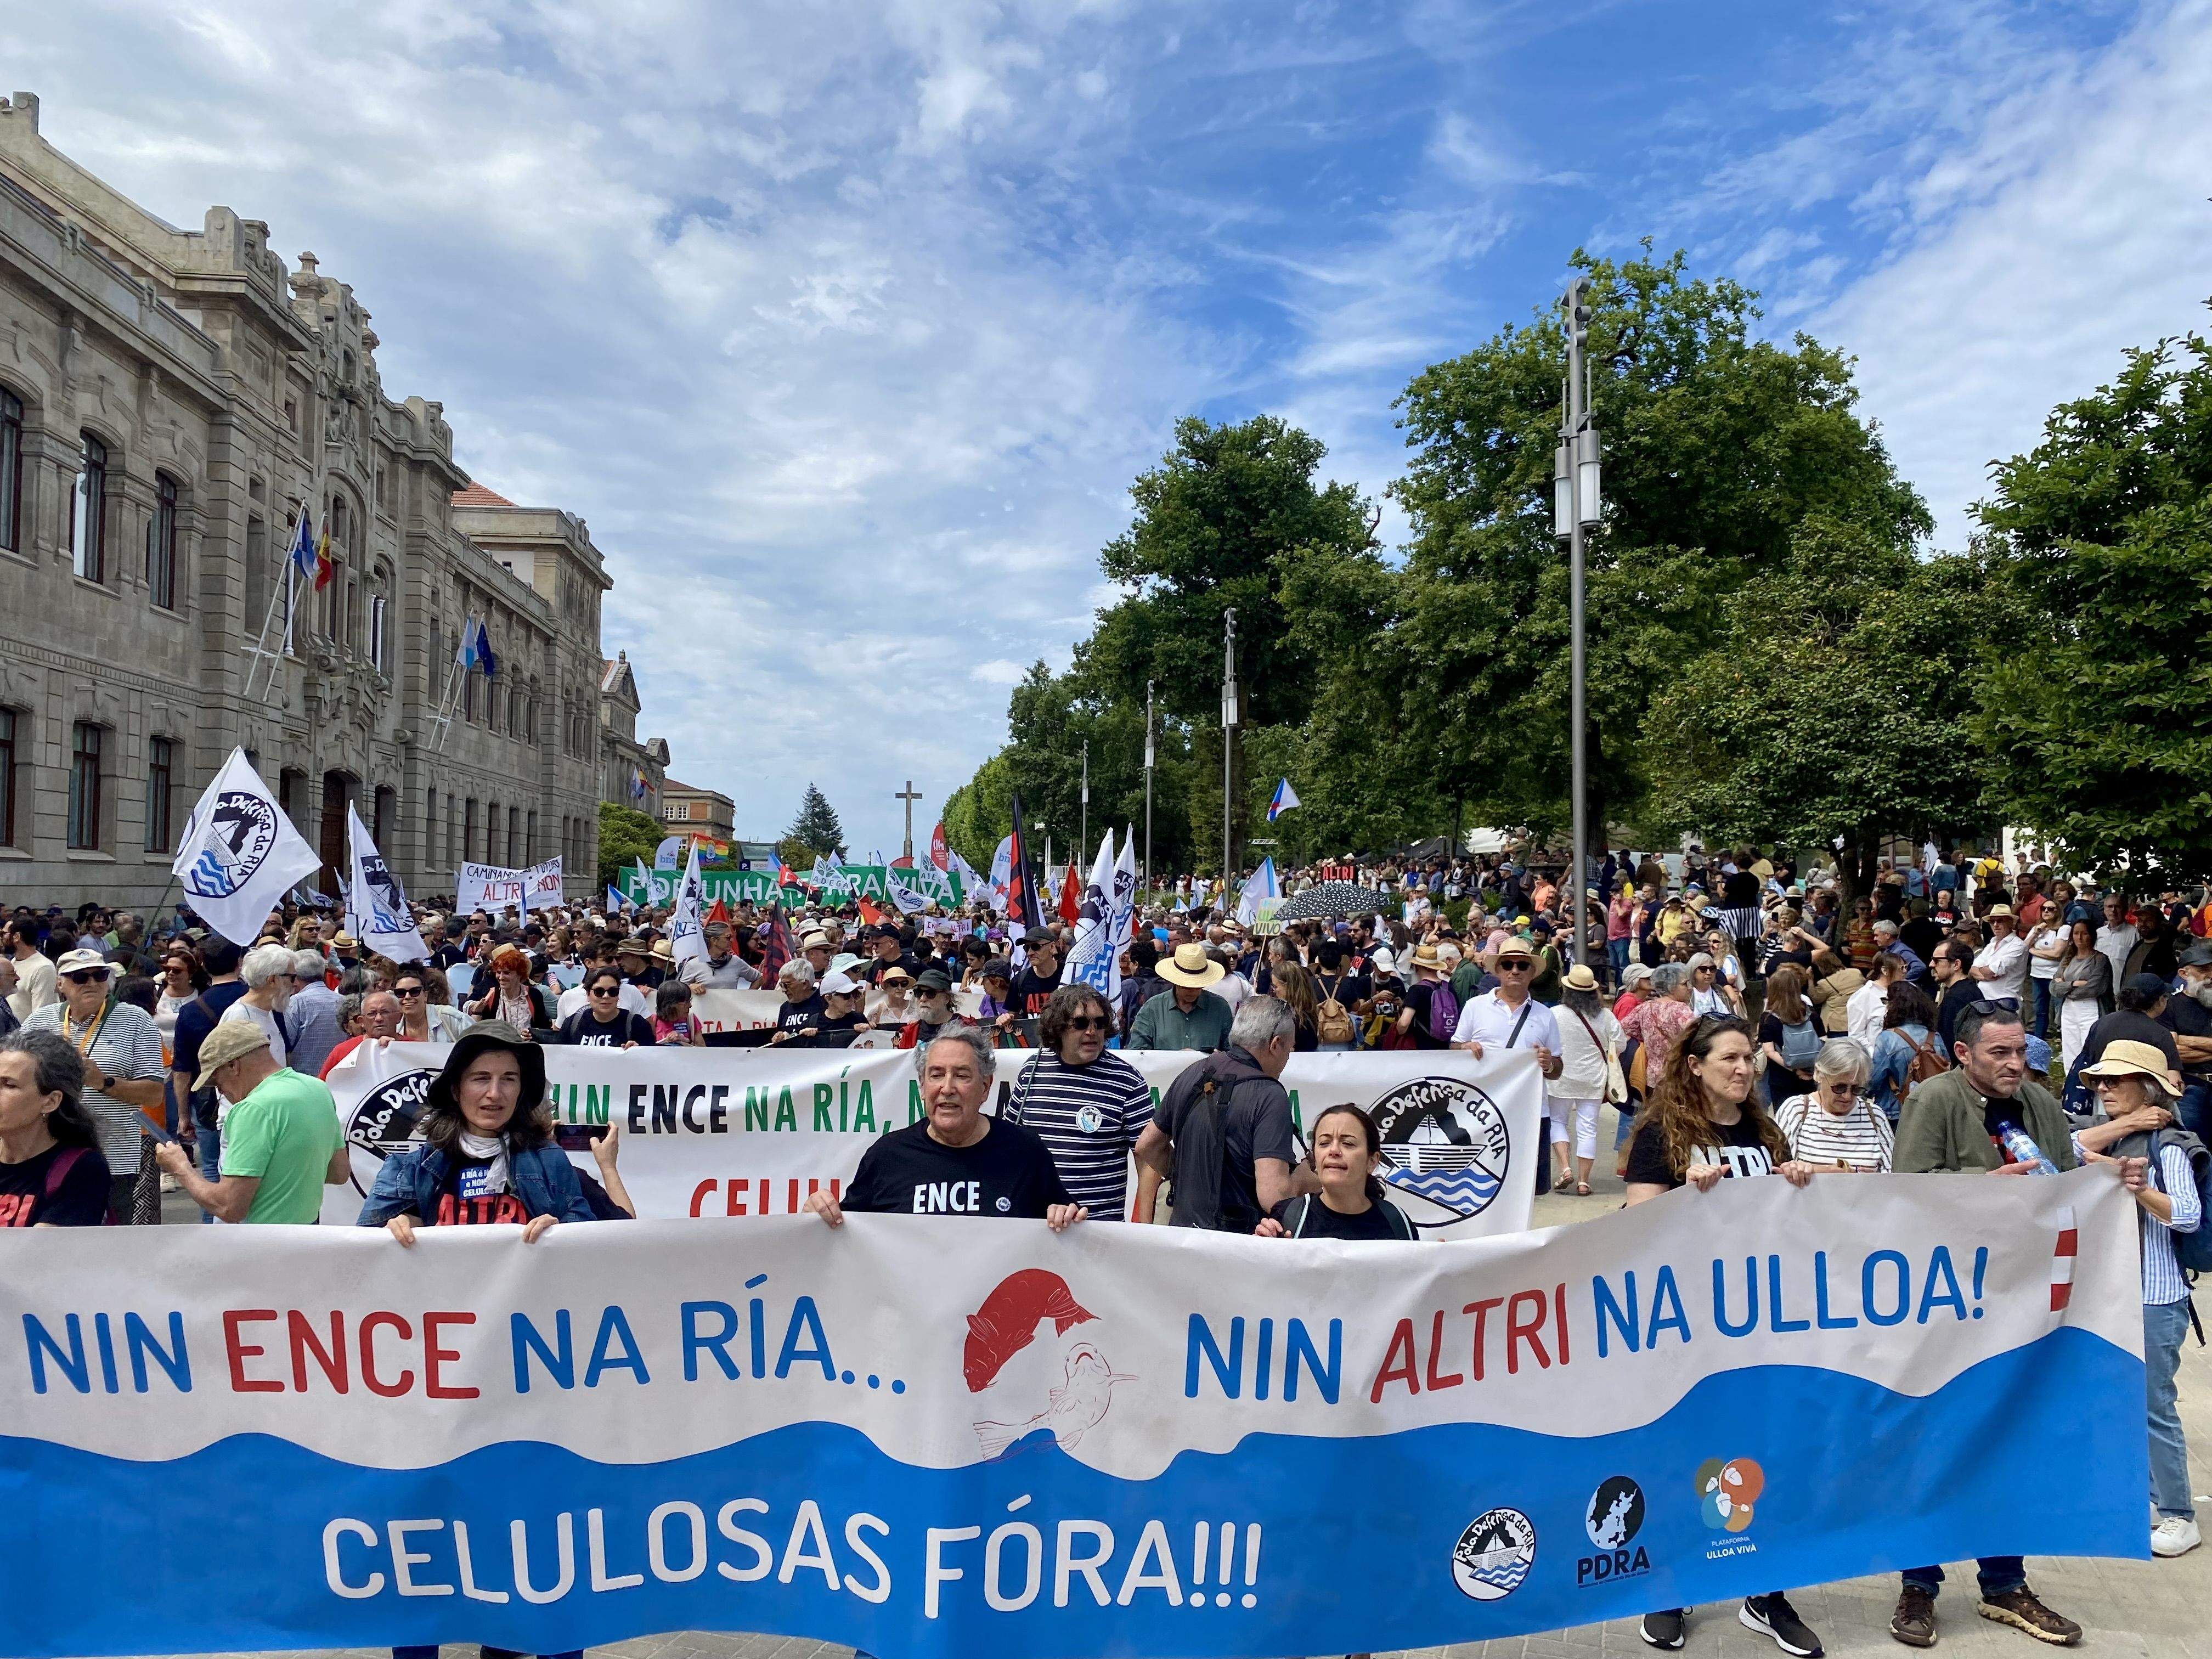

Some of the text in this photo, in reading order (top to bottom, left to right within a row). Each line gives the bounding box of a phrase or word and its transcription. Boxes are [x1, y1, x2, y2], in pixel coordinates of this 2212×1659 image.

[252, 835, 270, 853] da
[237, 855, 260, 876] RIA
[660, 854, 675, 865] bng
[998, 853, 1011, 863] bn
[1322, 865, 1354, 879] ALTRI
[702, 878, 785, 903] UNHA
[813, 876, 849, 888] ADEGA
[1256, 922, 1280, 935] VIVO
[1026, 993, 1051, 1013] ALT
[785, 1013, 809, 1026] ENCE
[580, 1035, 612, 1047] ENCE
[381, 1076, 436, 1109] Defe
[628, 1084, 729, 1134] ENCE
[745, 1085, 797, 1133] NA
[814, 1065, 893, 1135] RÍA,
[1385, 1084, 1467, 1115] Defensa
[1466, 1098, 1491, 1125] da
[1483, 1122, 1506, 1160] RIA
[461, 1172, 466, 1180] A
[913, 1181, 980, 1214] ENCE
[22, 1245, 1989, 1404] NIN ENCE NA RÍA... NIN ALTRI NA ULLOA!
[1471, 1511, 1516, 1536] Defensa
[1514, 1517, 1527, 1533] da
[1522, 1530, 1534, 1553] RIA
[1711, 1536, 1751, 1547] PLATAFORMA
[322, 1494, 1262, 1620] CELULOSAS FÓRA!!!
[1706, 1543, 1757, 1560] ULLOA VIVA
[1577, 1545, 1651, 1584] PDRA
